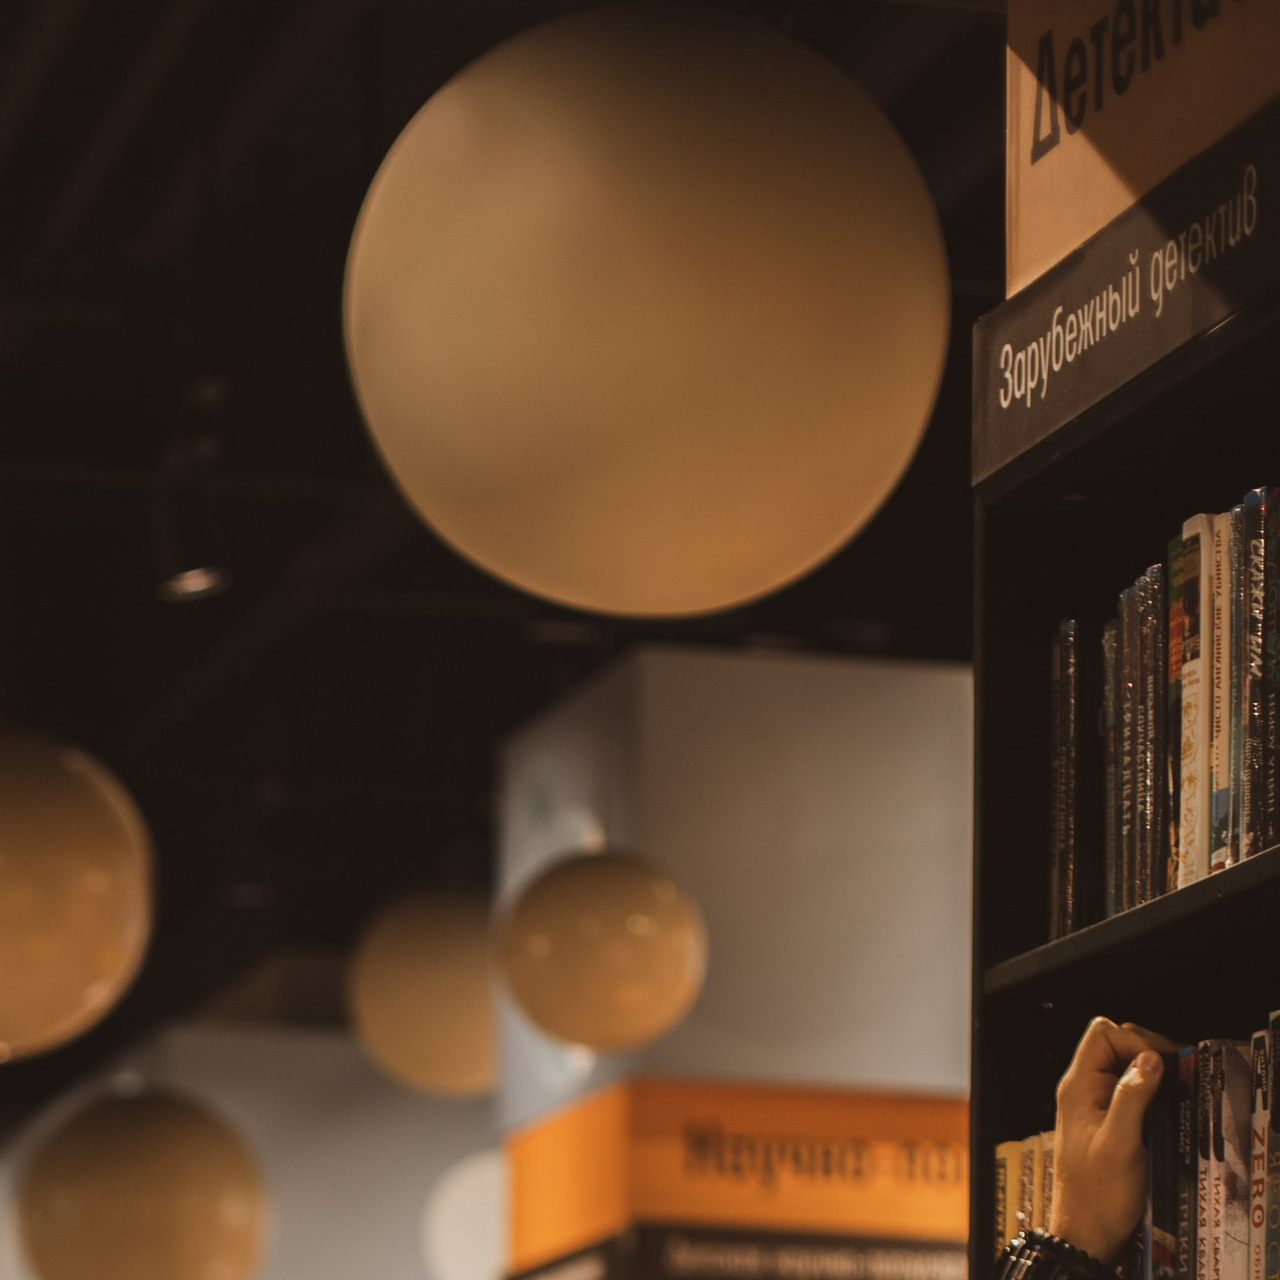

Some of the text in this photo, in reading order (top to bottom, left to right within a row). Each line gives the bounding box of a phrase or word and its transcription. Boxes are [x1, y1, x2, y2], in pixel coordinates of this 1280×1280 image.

[1030, 0, 1246, 166] Детек
[998, 163, 1258, 408] Зарубежный детектив
[1199, 1168, 1208, 1228] ТИХАЯ
[1213, 1175, 1222, 1228] ТИХАЯ
[1251, 1126, 1267, 1229] ZERO
[1179, 1186, 1191, 1273] ТРЕКИ
